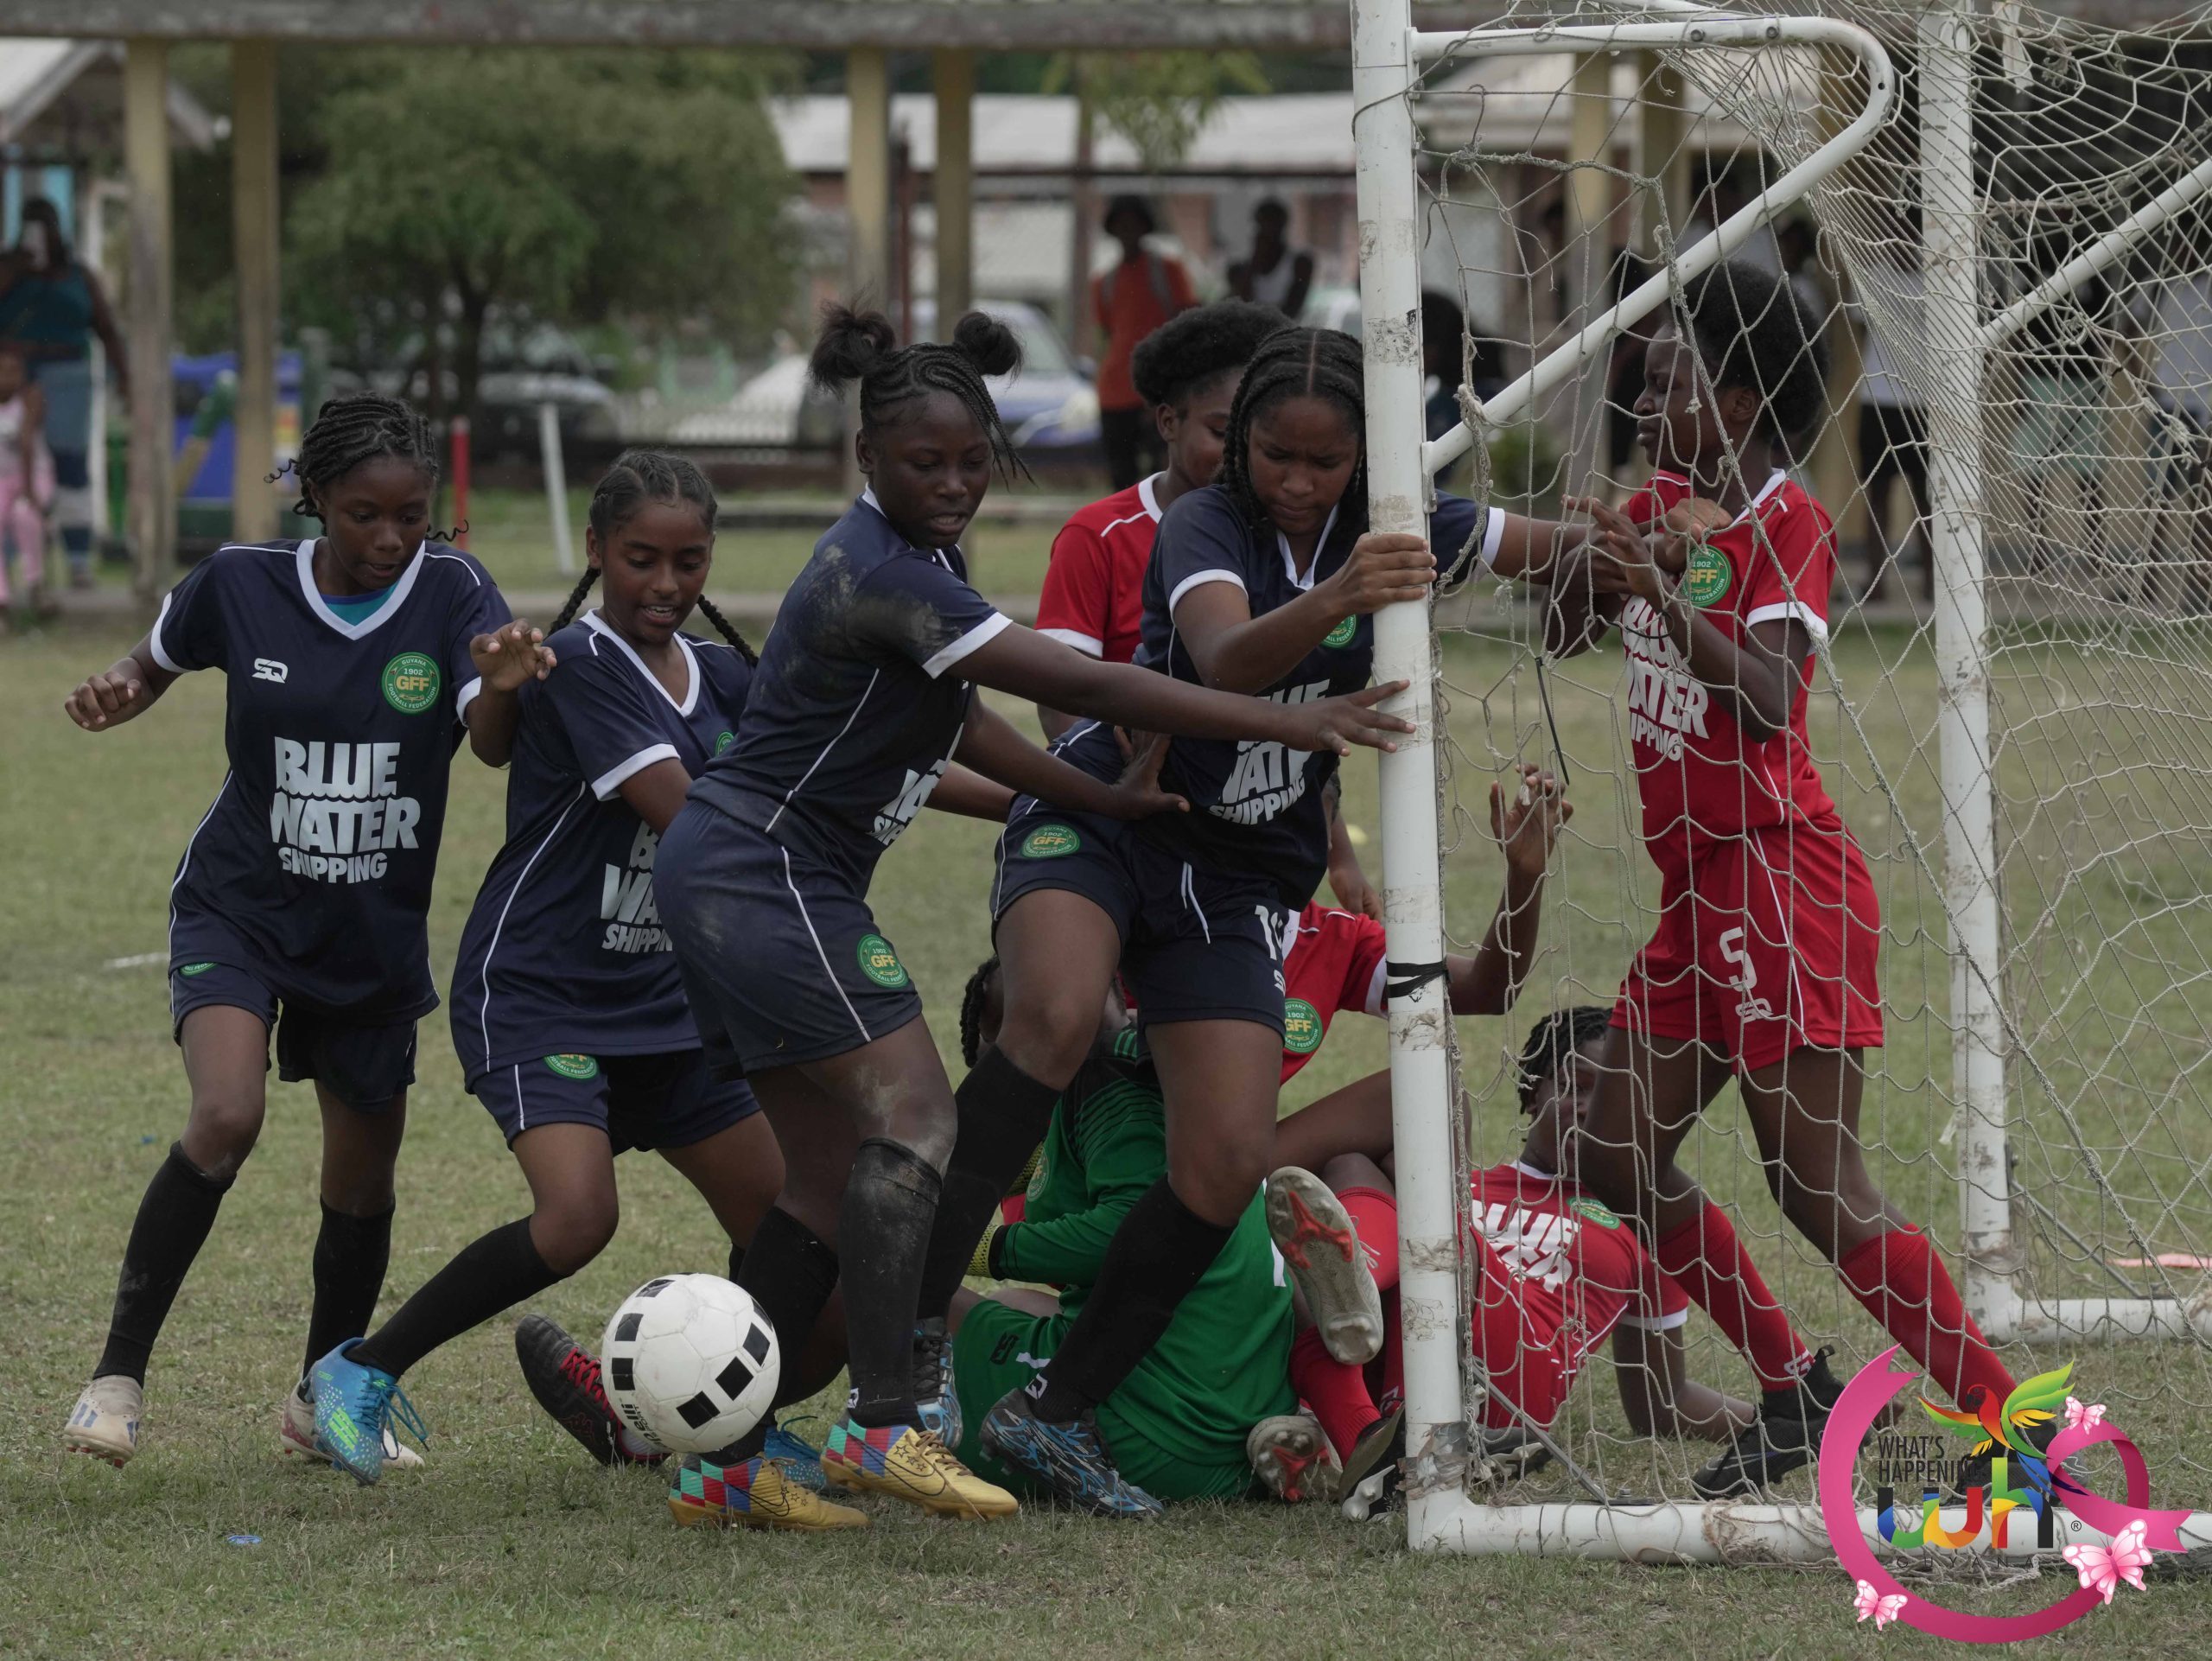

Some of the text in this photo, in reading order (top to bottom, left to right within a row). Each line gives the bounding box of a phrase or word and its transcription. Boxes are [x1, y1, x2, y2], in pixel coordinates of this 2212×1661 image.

[401, 658, 427, 667] GUYANA
[387, 683, 436, 709] FOOTBALL FEDERATION
[396, 675, 430, 691] GFF
[1627, 657, 1710, 740] ATER
[274, 736, 401, 800] BLUE
[1210, 775, 1306, 826] SHIPPING
[270, 790, 422, 855] WATER
[1033, 836, 1067, 845] GFF
[277, 846, 388, 884] SHIPPING
[601, 923, 673, 953] SHIPPIN
[870, 954, 896, 968] GFF
[1285, 1018, 1312, 1033] GFF
